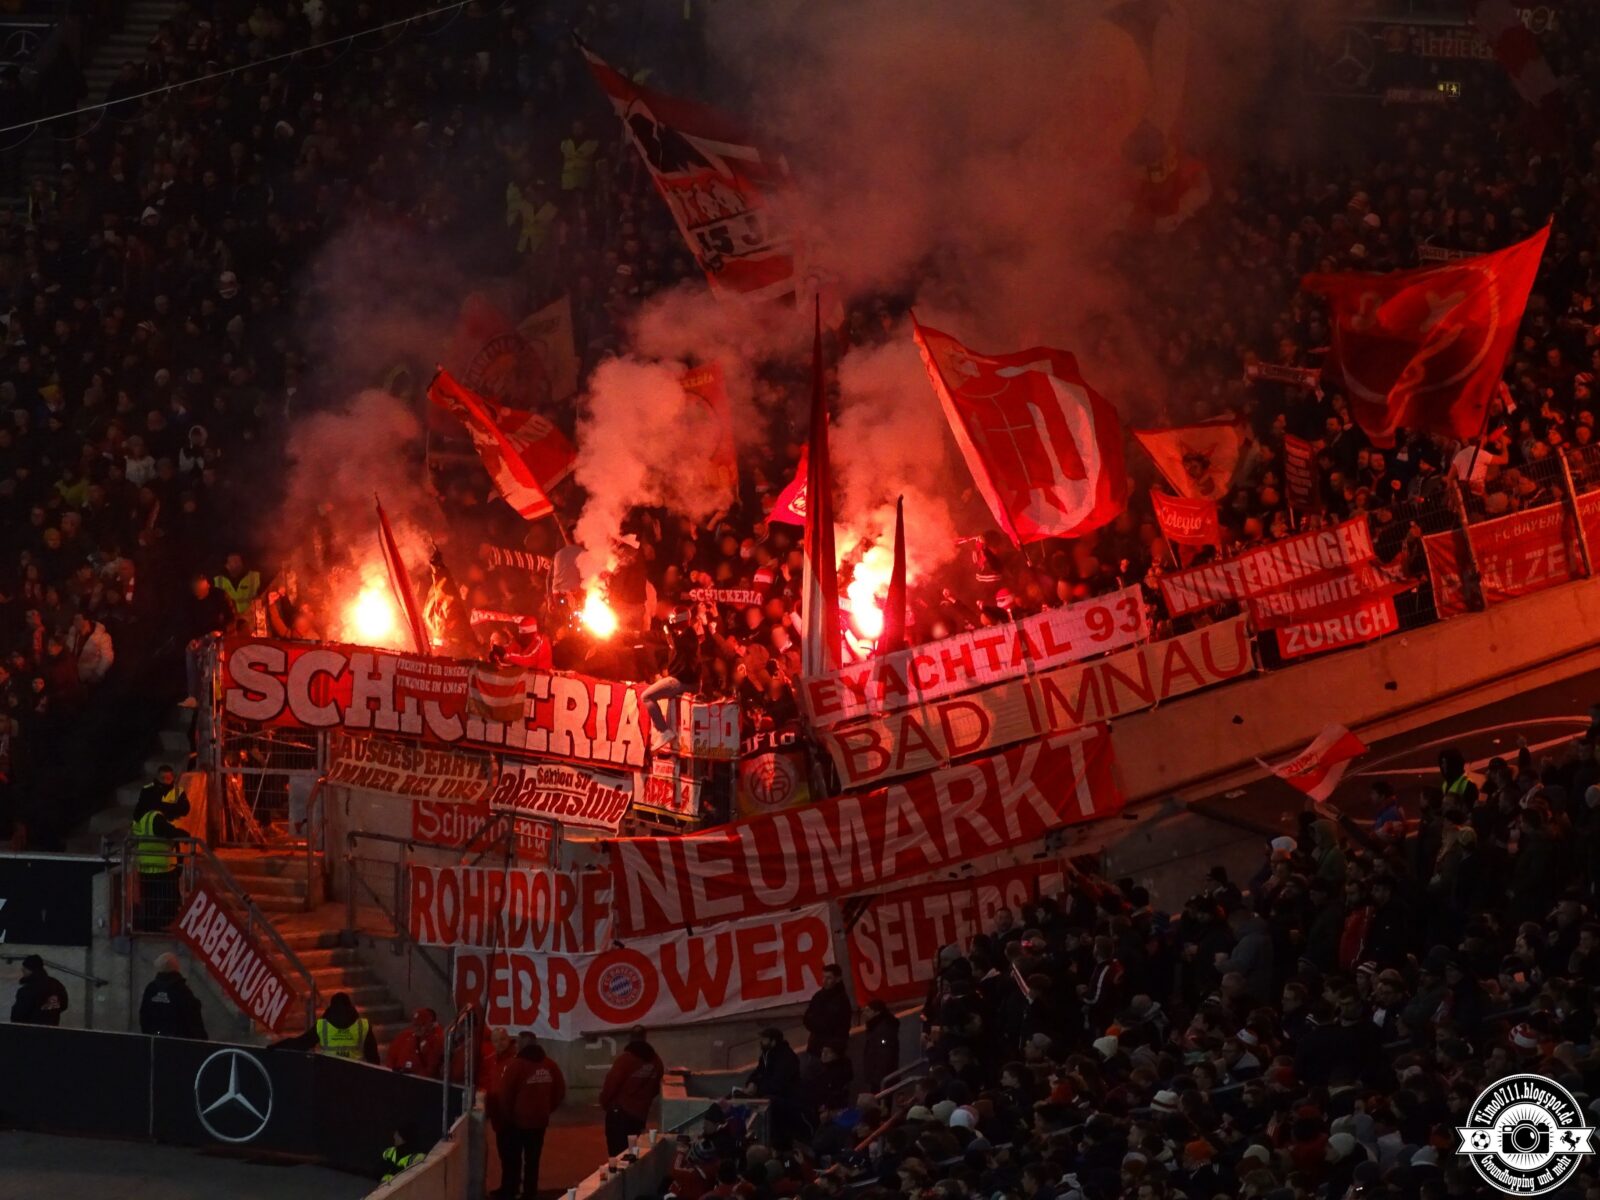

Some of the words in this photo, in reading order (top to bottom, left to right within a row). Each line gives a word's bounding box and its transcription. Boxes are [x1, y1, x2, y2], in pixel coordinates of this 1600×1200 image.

[689, 588, 763, 606] SCHICKERIA
[1164, 521, 1373, 613] WINTERLINGEN
[1295, 574, 1360, 610] WHITE
[808, 622, 1073, 716] EYACHTAL
[1084, 596, 1142, 642] 93
[1283, 602, 1391, 654] ZURICH
[833, 701, 990, 782] BAD
[1022, 620, 1248, 733] IMNAU
[331, 761, 399, 792] IMMER
[397, 774, 439, 797] BEI
[437, 777, 484, 801] UNS
[493, 769, 630, 825] alarmstufe
[537, 766, 574, 787] Sektion
[574, 772, 592, 790] SV
[618, 726, 1100, 933] NEUMARKT
[411, 867, 613, 953] ROHRDORF
[178, 890, 289, 1030] RABENAU/SN
